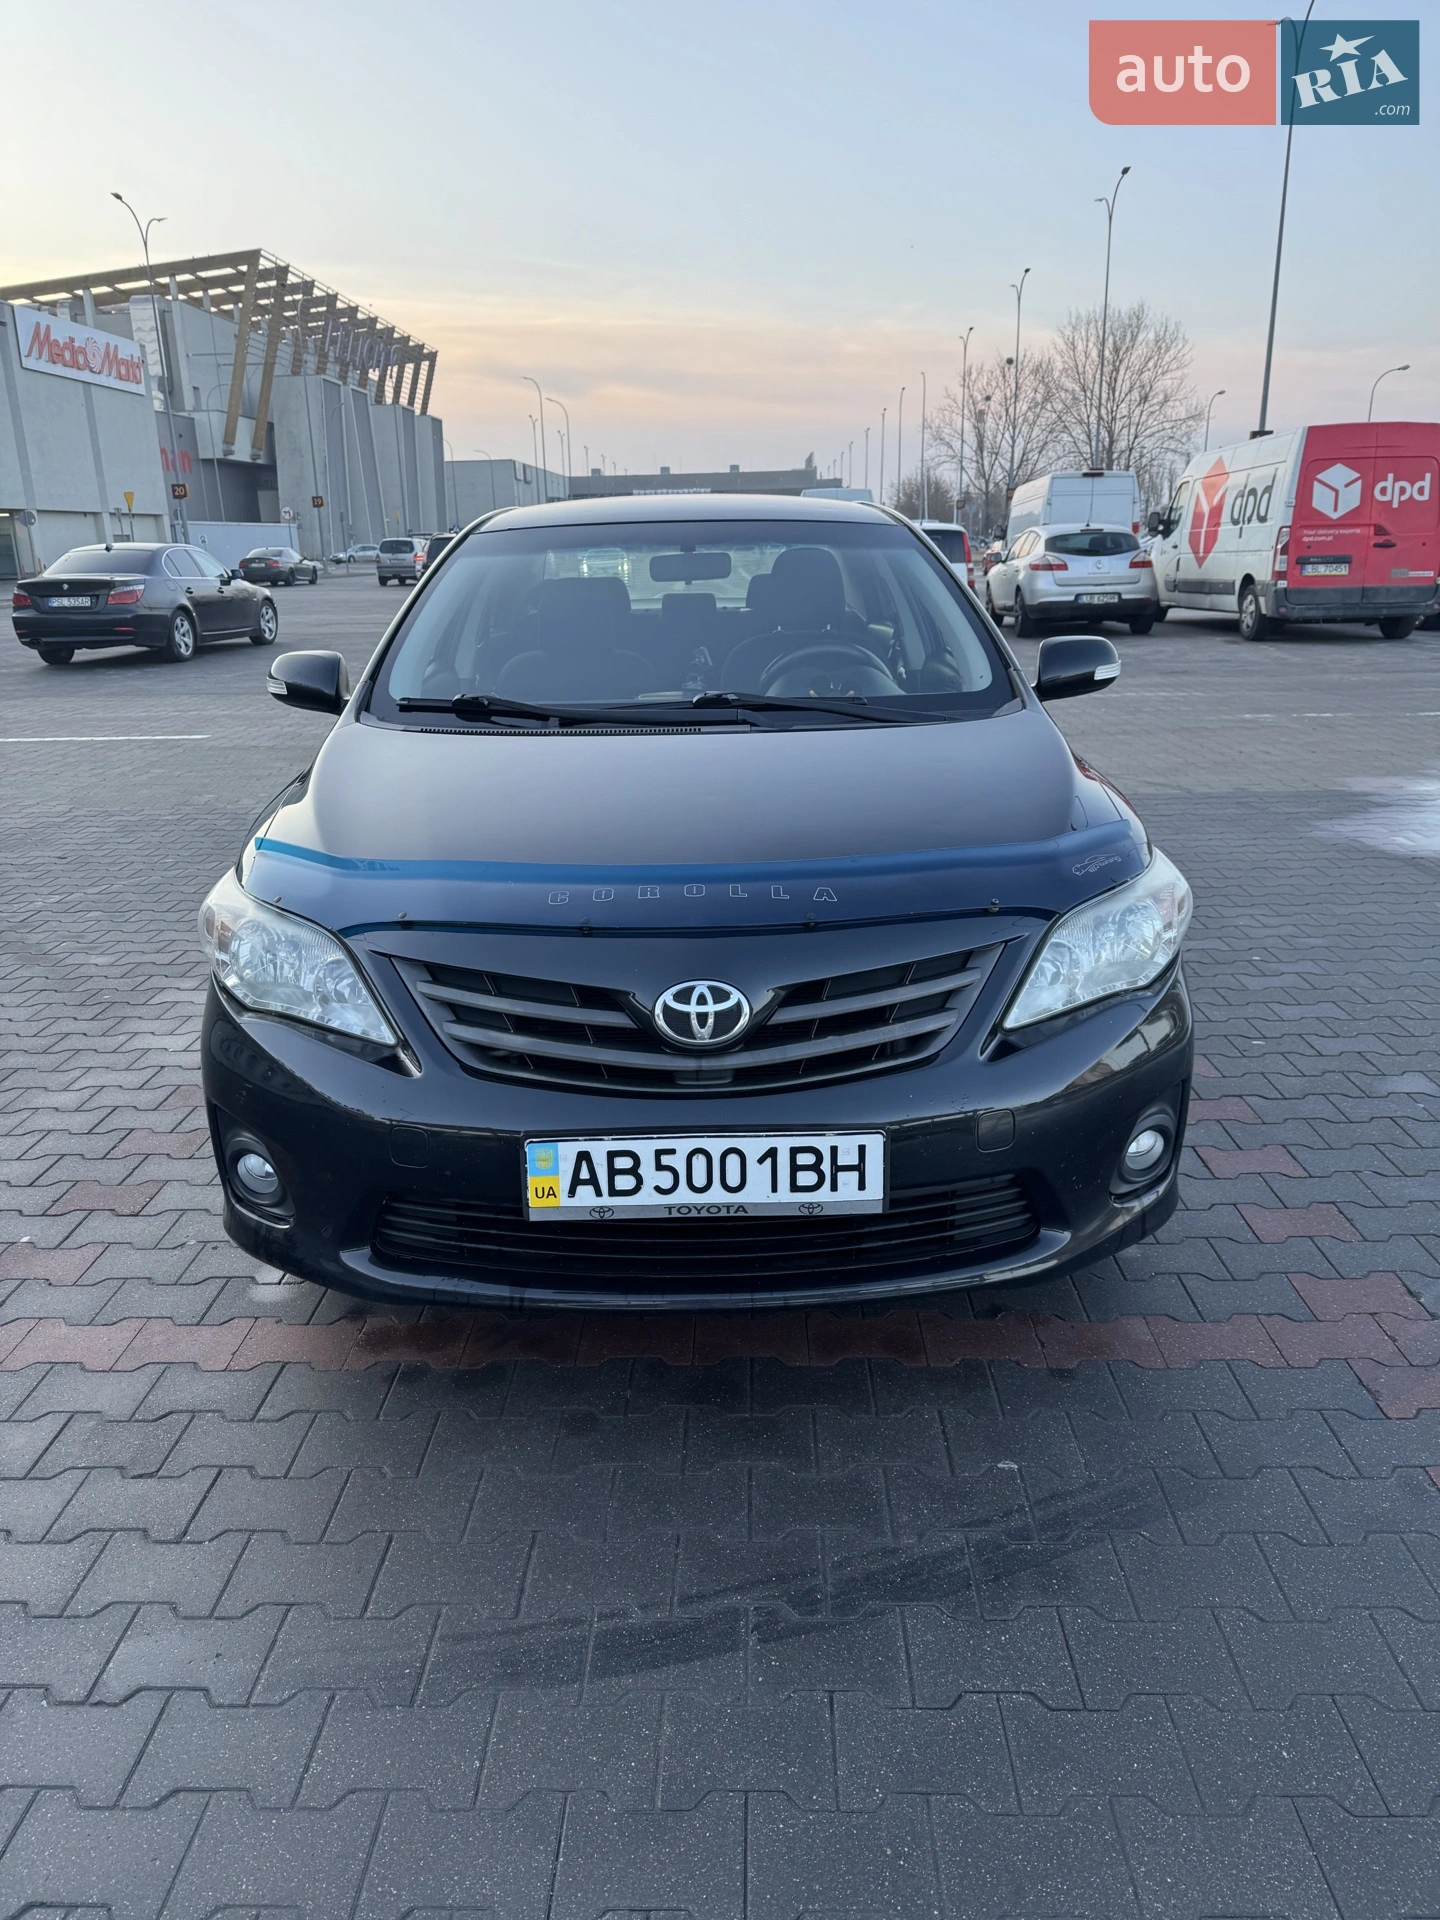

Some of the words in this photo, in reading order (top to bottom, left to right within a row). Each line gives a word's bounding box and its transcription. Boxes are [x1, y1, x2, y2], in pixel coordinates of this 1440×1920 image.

[26, 321, 88, 371] Media
[101, 341, 143, 385] Markt
[174, 486, 185, 496] 20
[1373, 472, 1431, 509] dpd
[313, 498, 322, 506] 19
[1230, 467, 1279, 539] dpd
[548, 883, 838, 905] COROLLA
[534, 1186, 558, 1199] UA
[663, 1204, 749, 1216] TOYOTA
